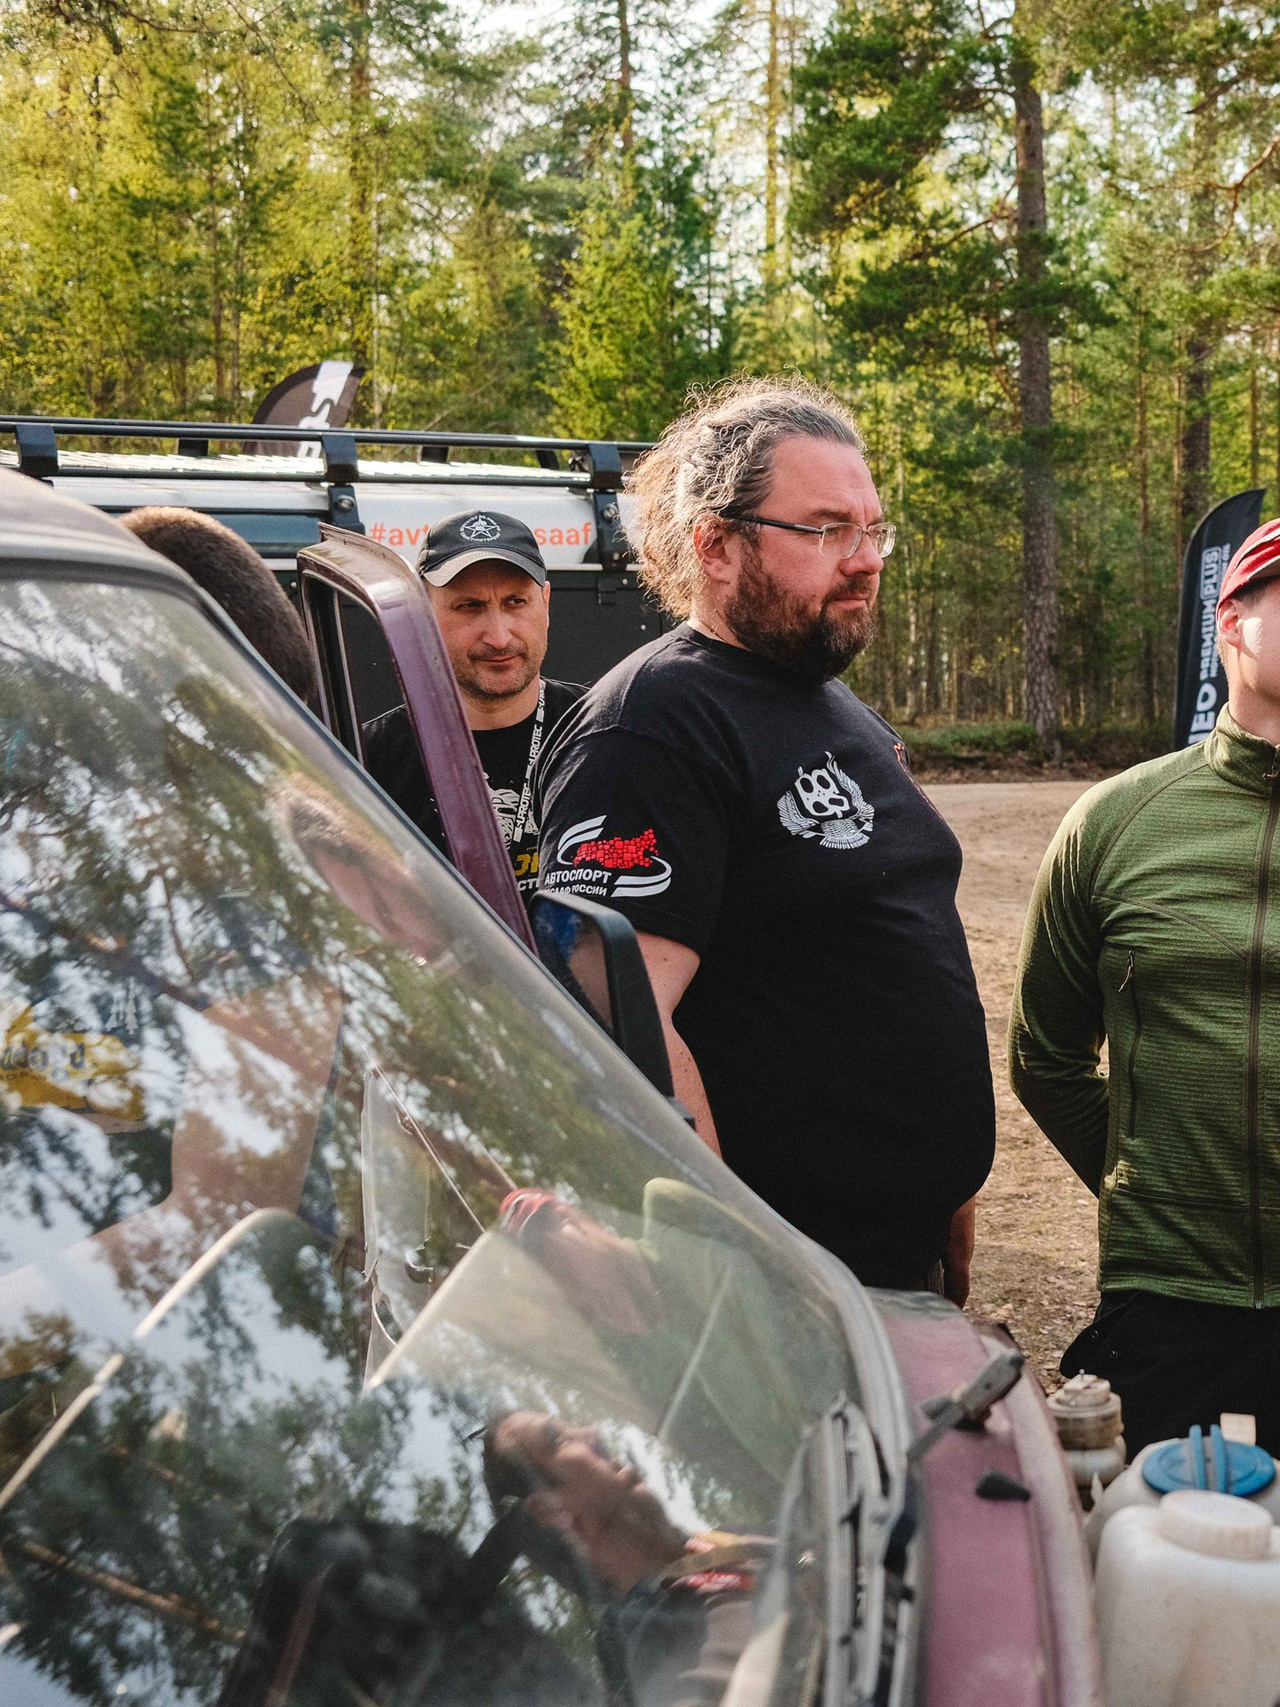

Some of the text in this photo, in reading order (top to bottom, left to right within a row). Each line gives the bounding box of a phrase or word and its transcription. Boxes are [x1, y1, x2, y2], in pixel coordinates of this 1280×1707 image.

[1202, 550, 1219, 597] PLUS
[1199, 599, 1215, 680] PREMIUM
[528, 724, 542, 768] SUPROTEC
[544, 868, 612, 886] АВТОСПОРТ
[572, 884, 607, 897] РОССИИ
